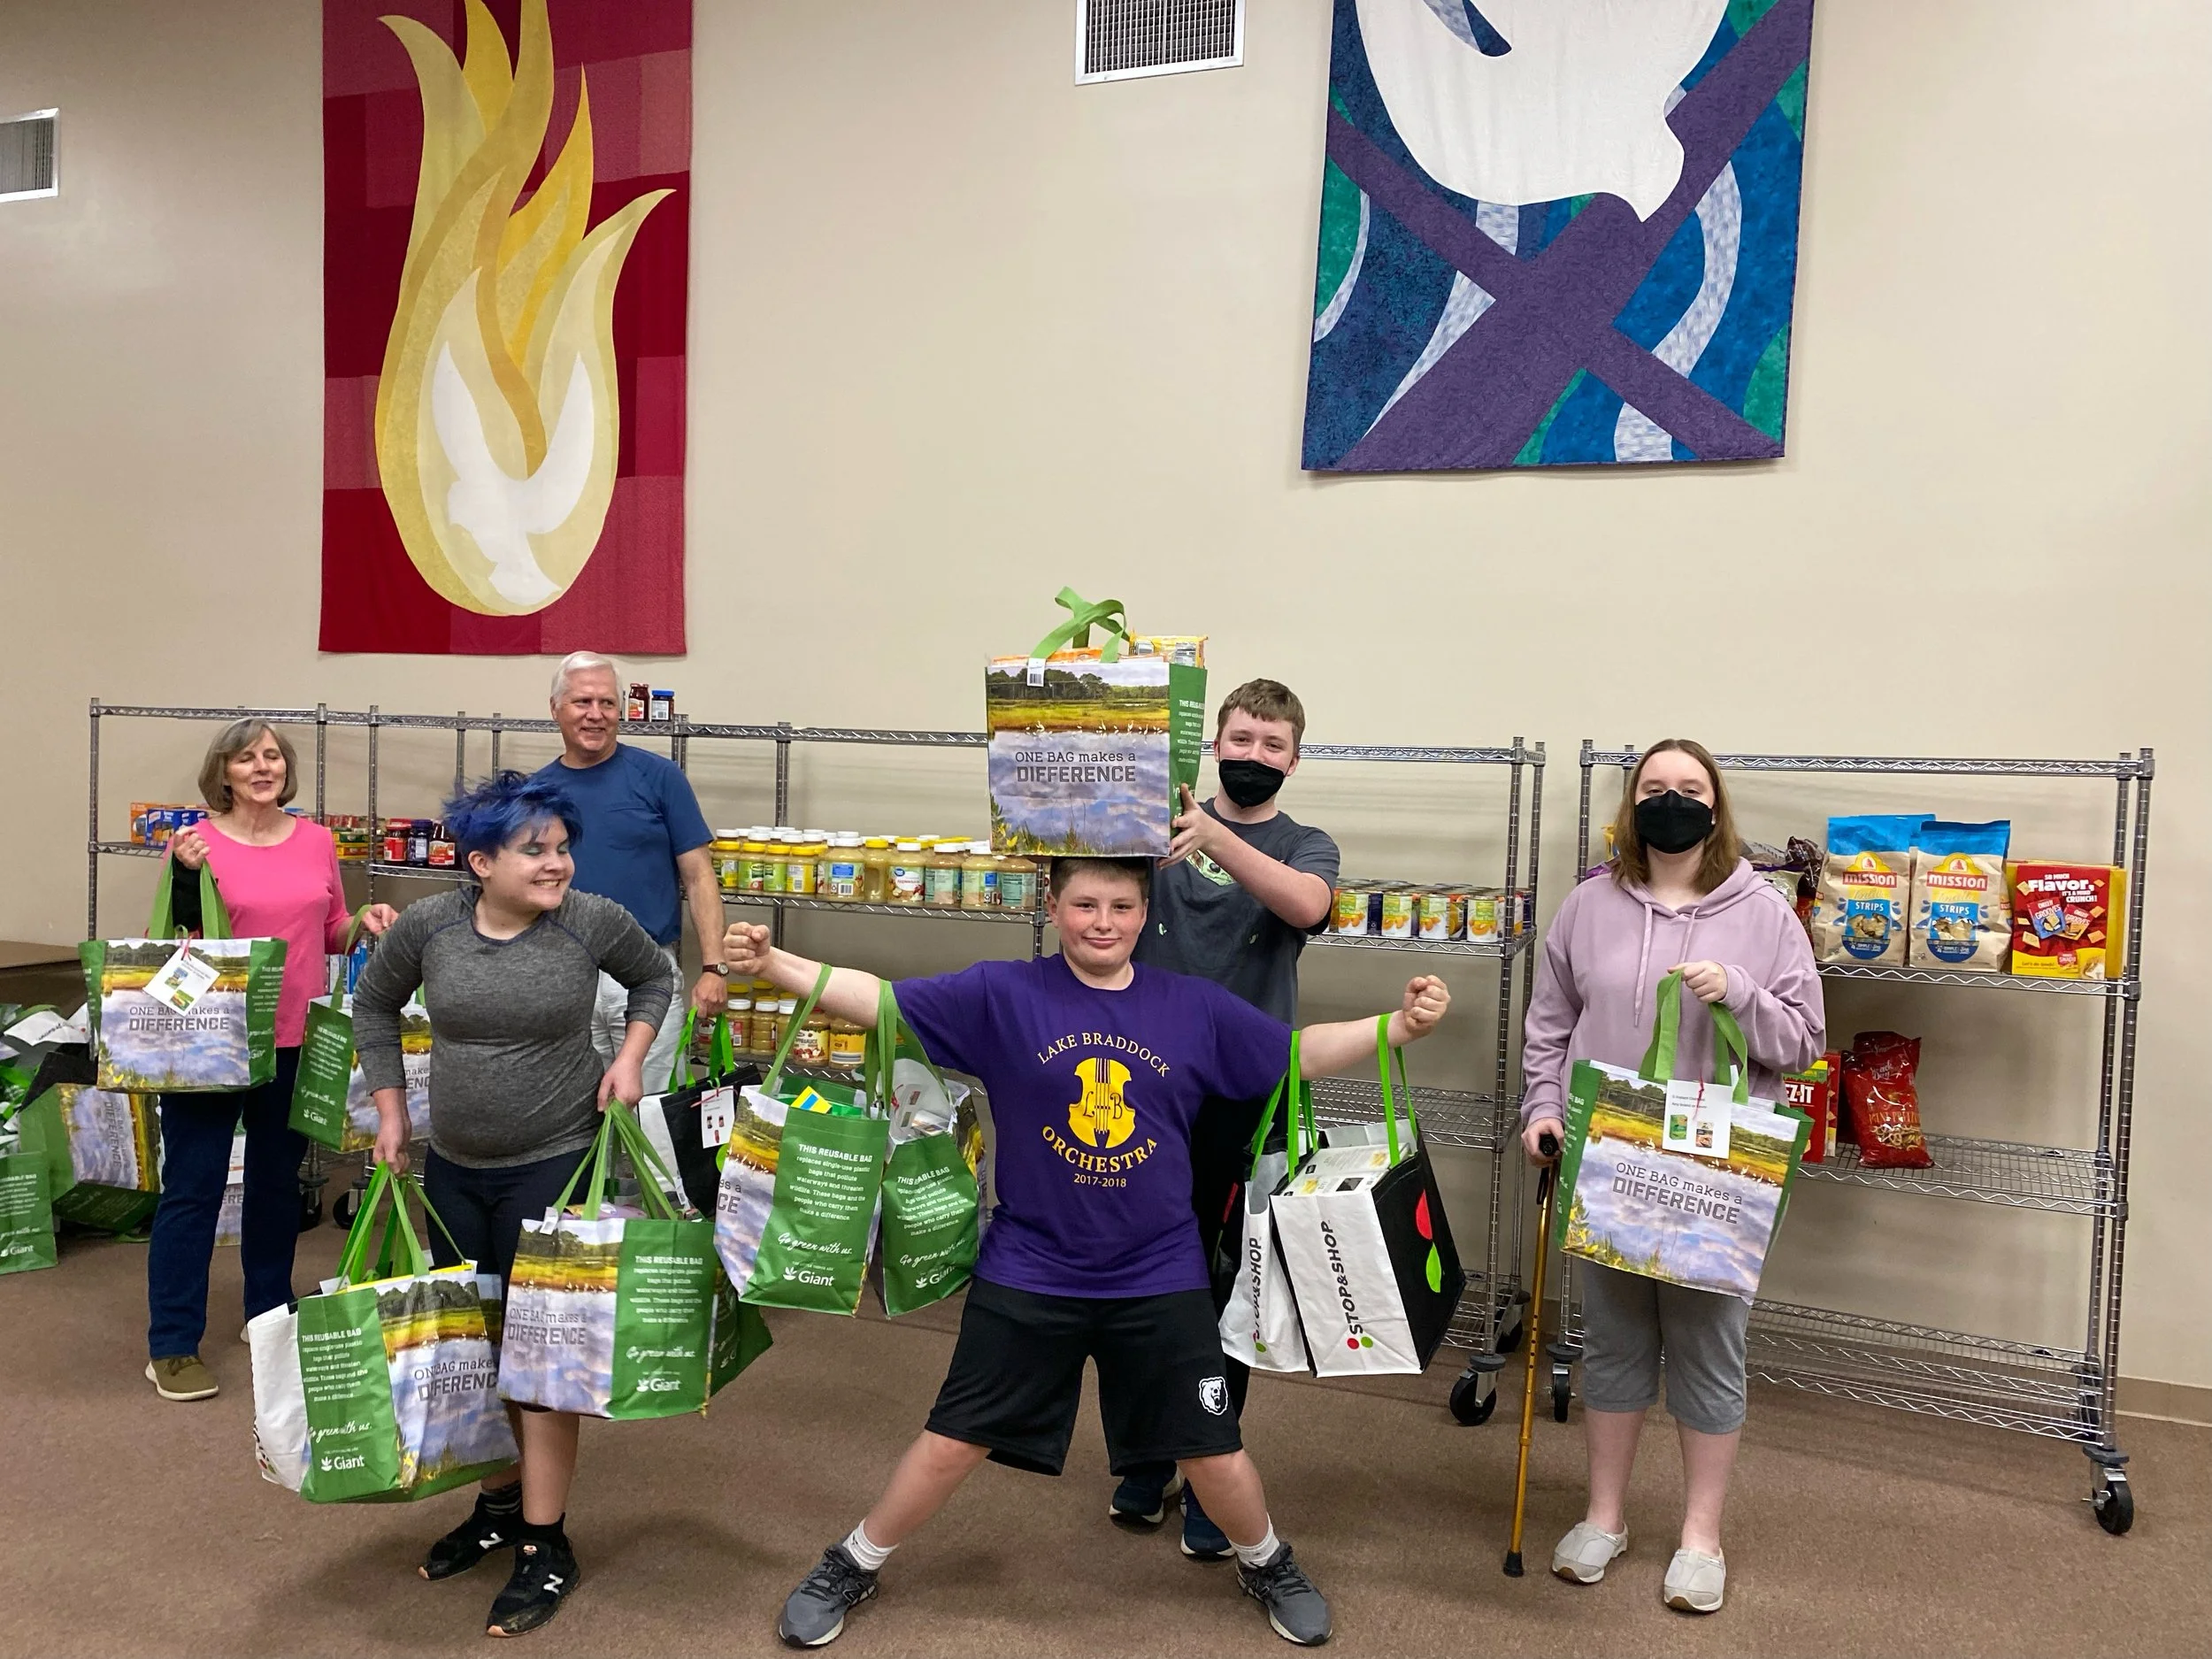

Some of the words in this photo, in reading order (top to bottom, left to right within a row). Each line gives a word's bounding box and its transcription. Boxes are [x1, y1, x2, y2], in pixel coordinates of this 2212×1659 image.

[1015, 751, 1043, 763] ONE
[1048, 751, 1075, 763] BAG
[1079, 751, 1124, 763] makes
[1128, 753, 1136, 762] a
[1017, 765, 1136, 782] DIFFERENCE
[2028, 879, 2094, 893] Flavor,
[1855, 902, 1885, 911] STRIPS
[1939, 904, 1970, 915] STRIPS
[129, 1006, 155, 1016] ONE
[187, 1004, 222, 1016] akes
[129, 1018, 229, 1031] DIFFERENCE
[1037, 1033, 1078, 1064] LAKE
[1081, 1032, 1171, 1078] BRADDOCK
[104, 1101, 122, 1168] DIFFERENCE
[799, 1144, 817, 1154] THIS
[818, 1148, 858, 1162] REUSABLE
[1041, 1125, 1158, 1173] ORCHESTRA
[796, 1156, 821, 1165] replaces
[822, 1160, 852, 1171] single-use
[796, 1176, 828, 1187] waterways
[897, 1176, 914, 1185] THIS
[935, 1166, 950, 1176] BAG
[1073, 1173, 1127, 1188] 2017-2018
[735, 1185, 741, 1194] a
[1617, 1162, 1647, 1179] ONE
[1649, 1171, 1679, 1187] BAG
[1683, 1180, 1731, 1202] makes
[1733, 1194, 1742, 1205] a
[1612, 1176, 1740, 1225] DIFFERENCE
[10, 1245, 34, 1255] Giant
[778, 1233, 791, 1244] Go
[787, 1240, 818, 1251] green
[818, 1242, 841, 1254] with
[654, 1256, 688, 1265] REUSABLE
[899, 1254, 912, 1265] Go
[911, 1252, 938, 1268] green
[798, 1270, 834, 1286] Giant
[1321, 1221, 1363, 1335] STOP&SHOP
[509, 1308, 529, 1320] ONE
[546, 1312, 580, 1324] makes
[580, 1313, 588, 1323] a
[314, 1330, 345, 1341] REUSABLE
[346, 1327, 362, 1337] BAG
[507, 1323, 587, 1345] DIFFERENCE
[459, 1357, 493, 1371] make
[649, 1378, 681, 1392] Giant
[358, 1422, 372, 1432] us.
[334, 1455, 365, 1470] Giant
[543, 1573, 564, 1594] N
